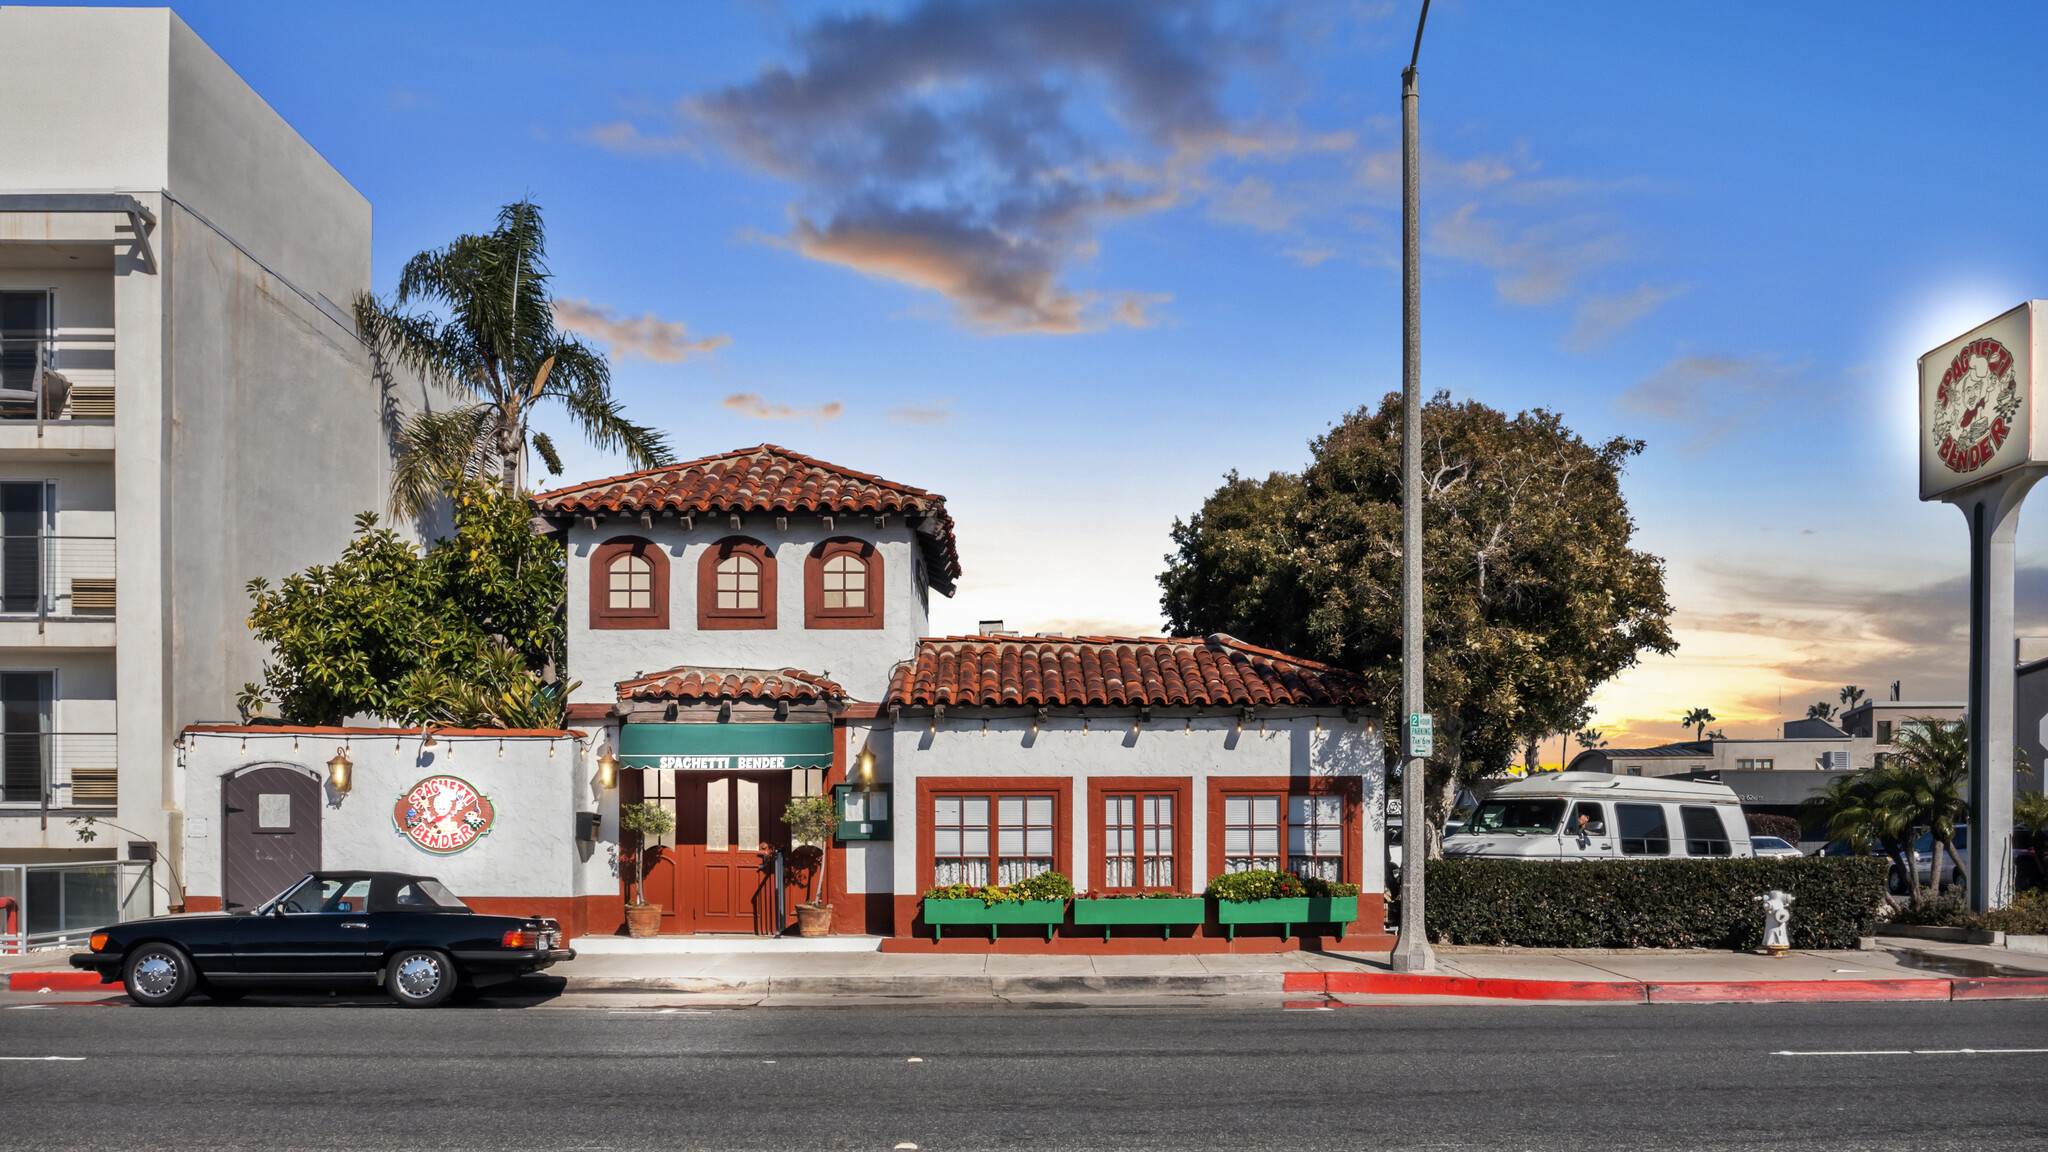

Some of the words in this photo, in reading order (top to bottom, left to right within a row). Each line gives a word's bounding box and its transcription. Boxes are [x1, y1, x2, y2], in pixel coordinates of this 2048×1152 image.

[1938, 416, 2010, 473] BENDER
[1412, 716, 1418, 726] 2
[660, 757, 730, 769] SPAGHETTI
[738, 757, 785, 769] BENDER
[412, 825, 474, 848] BENDER
